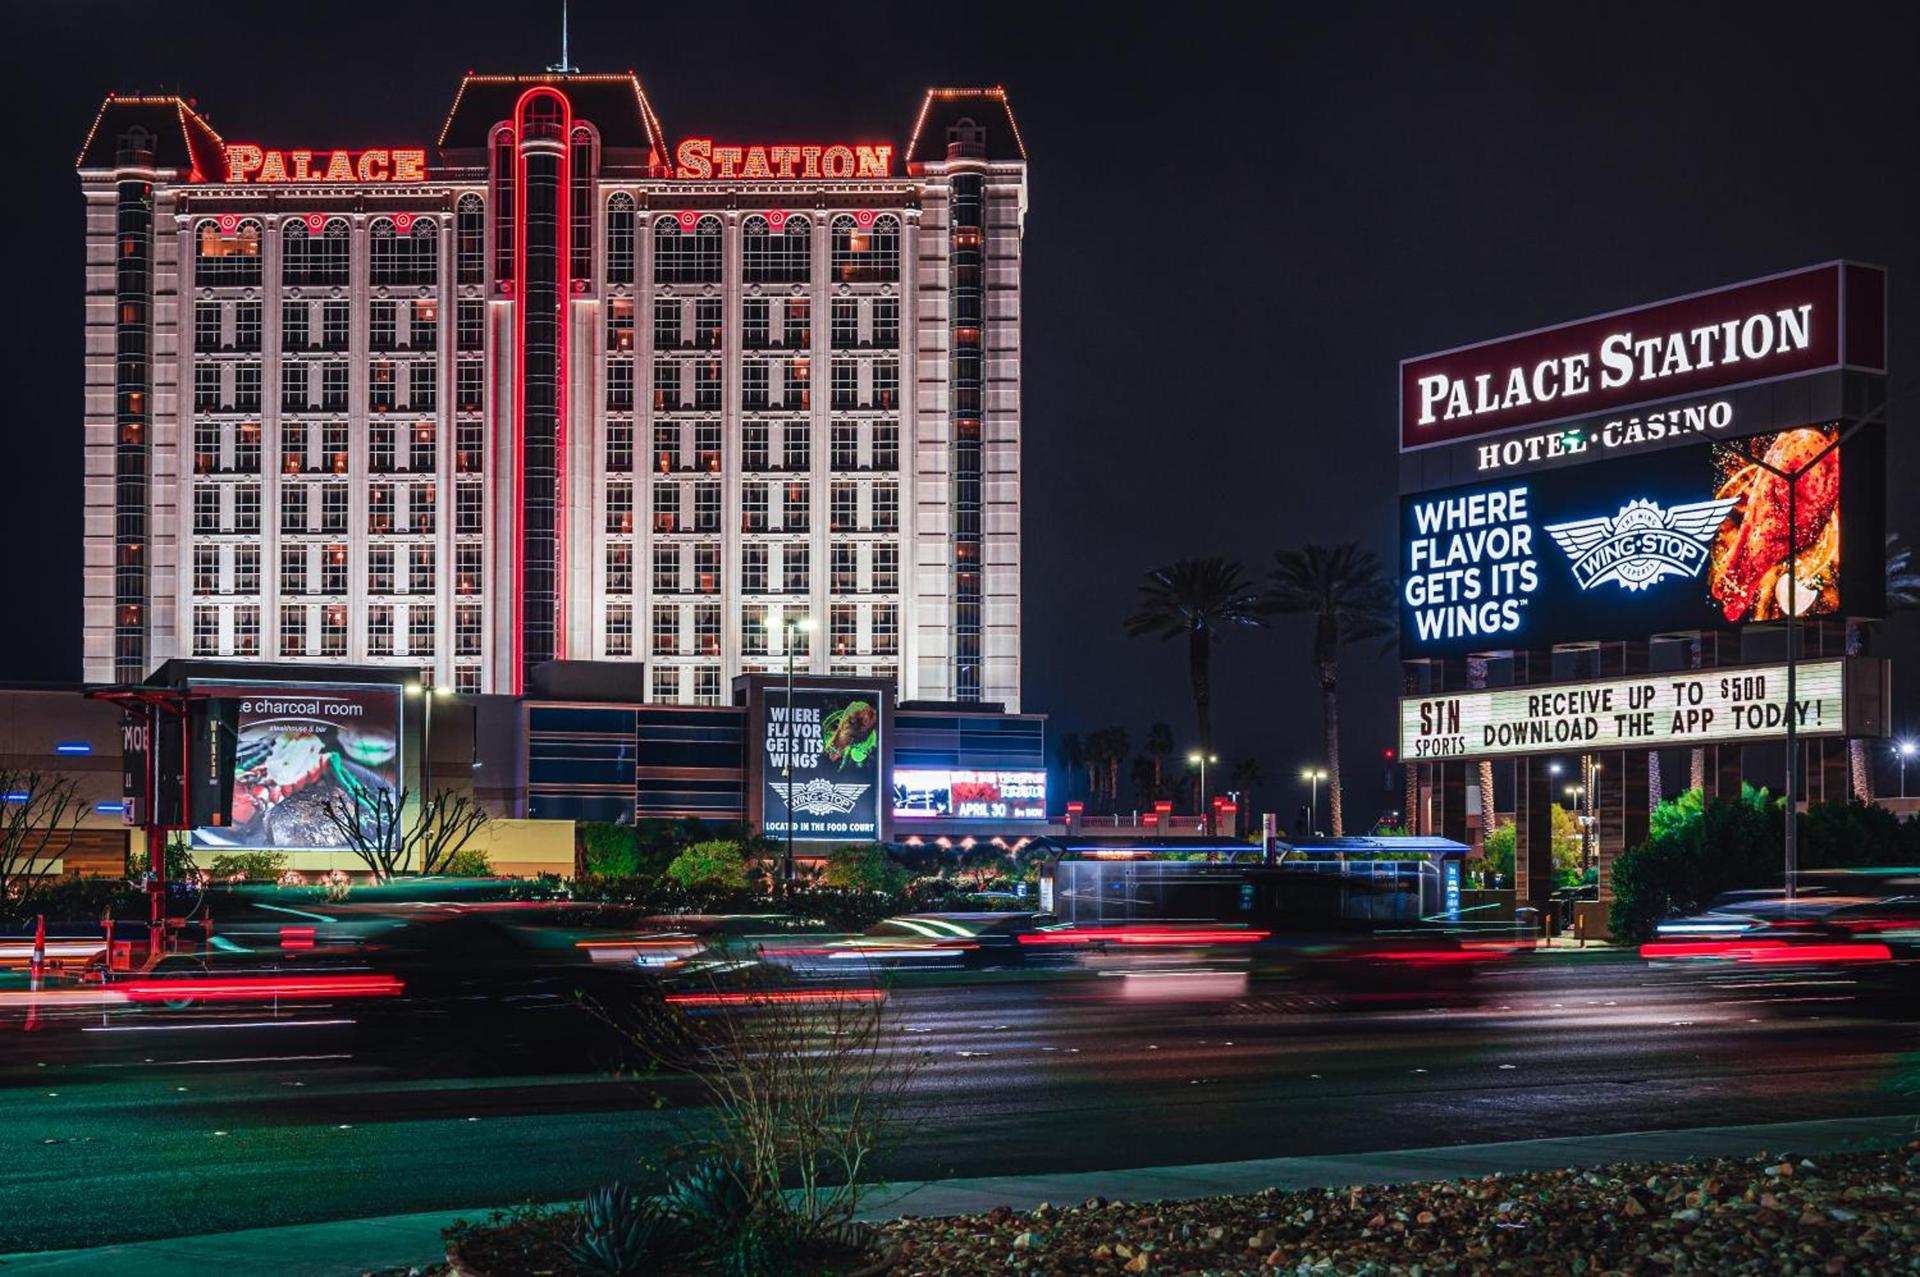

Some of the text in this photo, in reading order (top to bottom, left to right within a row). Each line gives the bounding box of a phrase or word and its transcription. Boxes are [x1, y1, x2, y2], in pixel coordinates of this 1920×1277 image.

[225, 138, 893, 183] PALACE STATION
[1417, 303, 1813, 427] PALACE STATION
[1414, 486, 1528, 535] WHERE
[1411, 524, 1533, 572] FLAVOR
[1405, 559, 1539, 607] GETS ITS
[255, 699, 320, 715] charcoal
[324, 703, 364, 716] room
[770, 707, 821, 723] WHERE
[1528, 675, 1766, 718] RECEIVE UP TO $500
[767, 722, 822, 738] FLAVOR
[1420, 699, 1460, 736] STN
[1483, 716, 1599, 747] DOWNLOAD
[1613, 712, 1655, 738] THE
[1671, 707, 1714, 735] APP
[804, 739, 824, 753] ITS
[1415, 736, 1466, 757] SPORTS
[766, 822, 875, 832] LOCATD IN THE FOOD COURT
[958, 802, 990, 817] APRIL
[991, 803, 1007, 817] 30
